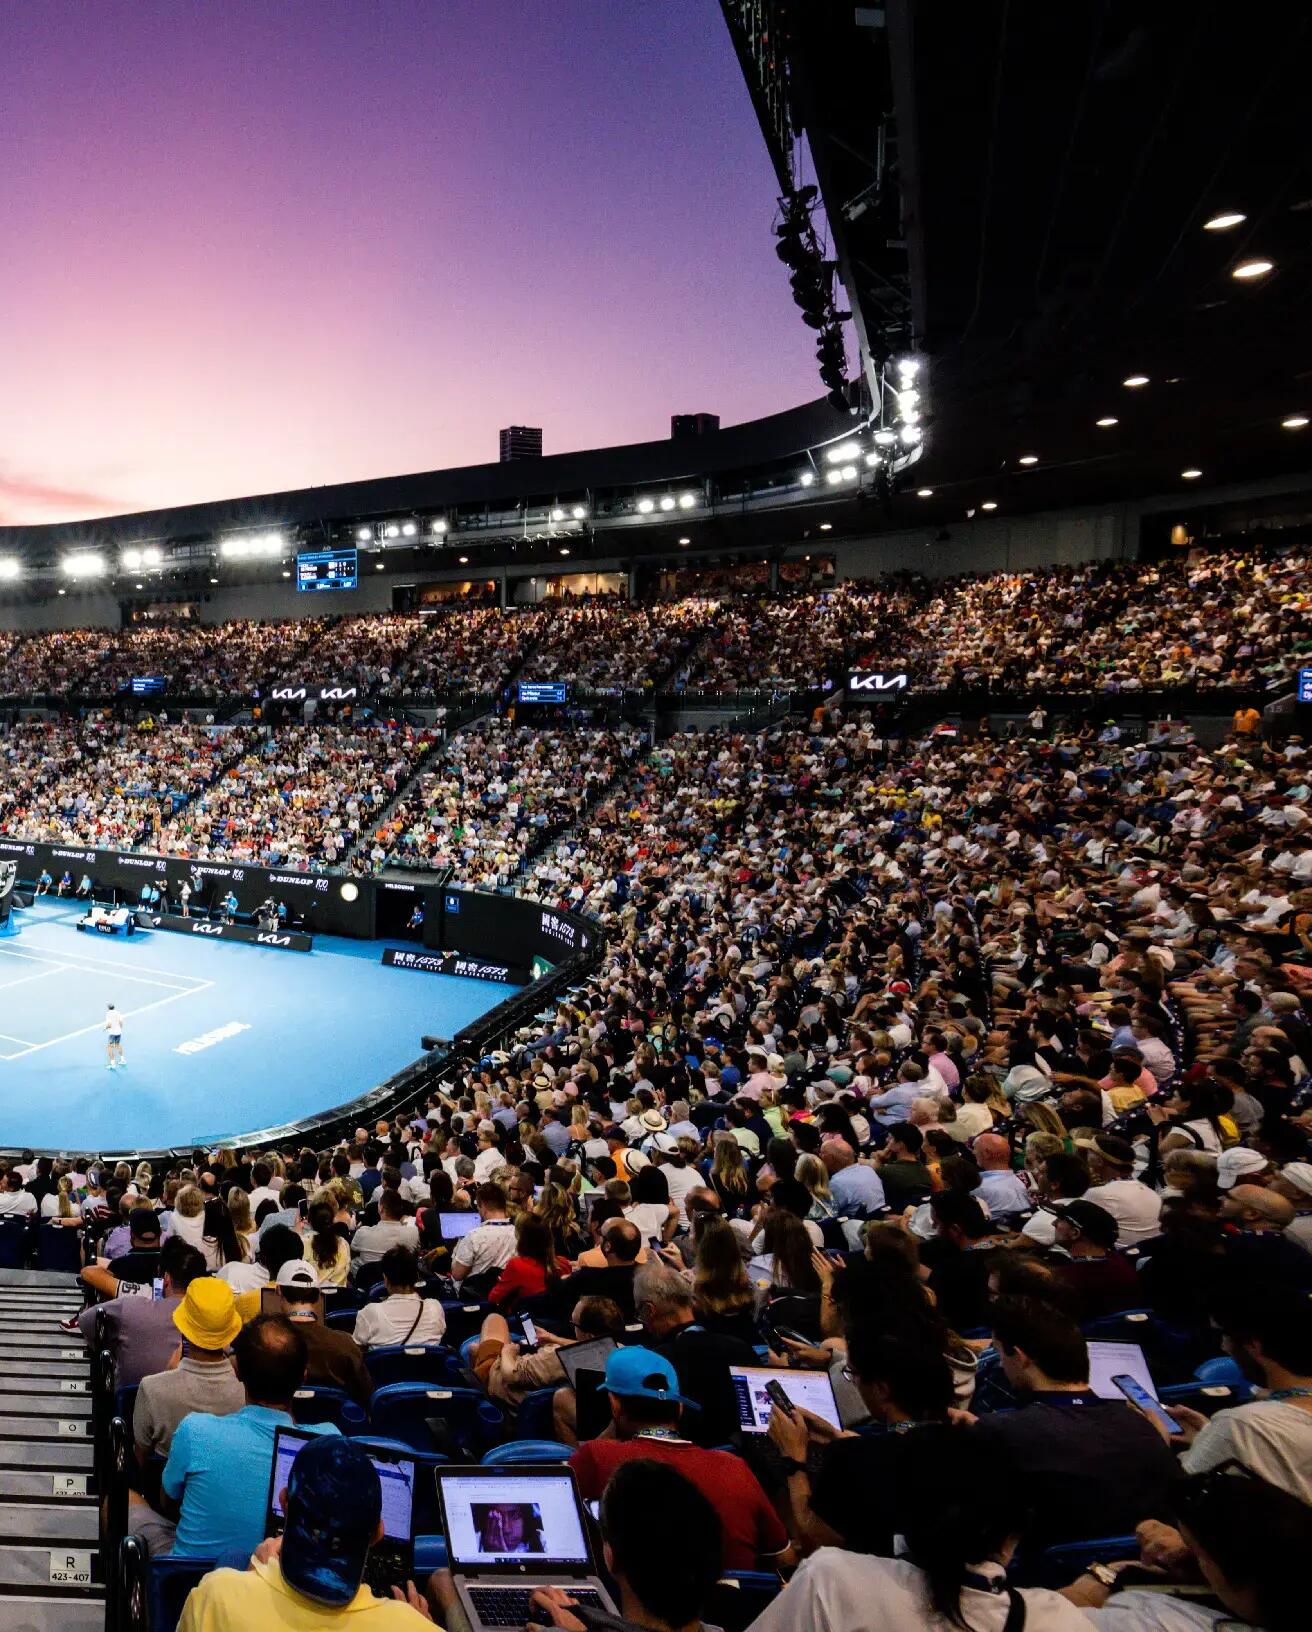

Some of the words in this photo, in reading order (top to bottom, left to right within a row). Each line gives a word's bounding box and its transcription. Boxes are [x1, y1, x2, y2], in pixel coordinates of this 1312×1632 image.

[851, 675, 906, 689] KIA
[272, 688, 306, 699] KIA
[321, 688, 356, 699] KIA
[0, 843, 25, 852] DUNLOP
[57, 851, 85, 859] DUNLOP
[123, 858, 154, 867] DUNLOP
[197, 867, 231, 876] DUNLOP
[276, 875, 314, 885] DUNLOP
[192, 922, 223, 935] KIA
[257, 933, 290, 946] KIA
[68, 1424, 76, 1432] O
[66, 1478, 74, 1488] P
[66, 1556, 75, 1568] R
[52, 1572, 90, 1582] 423-407
